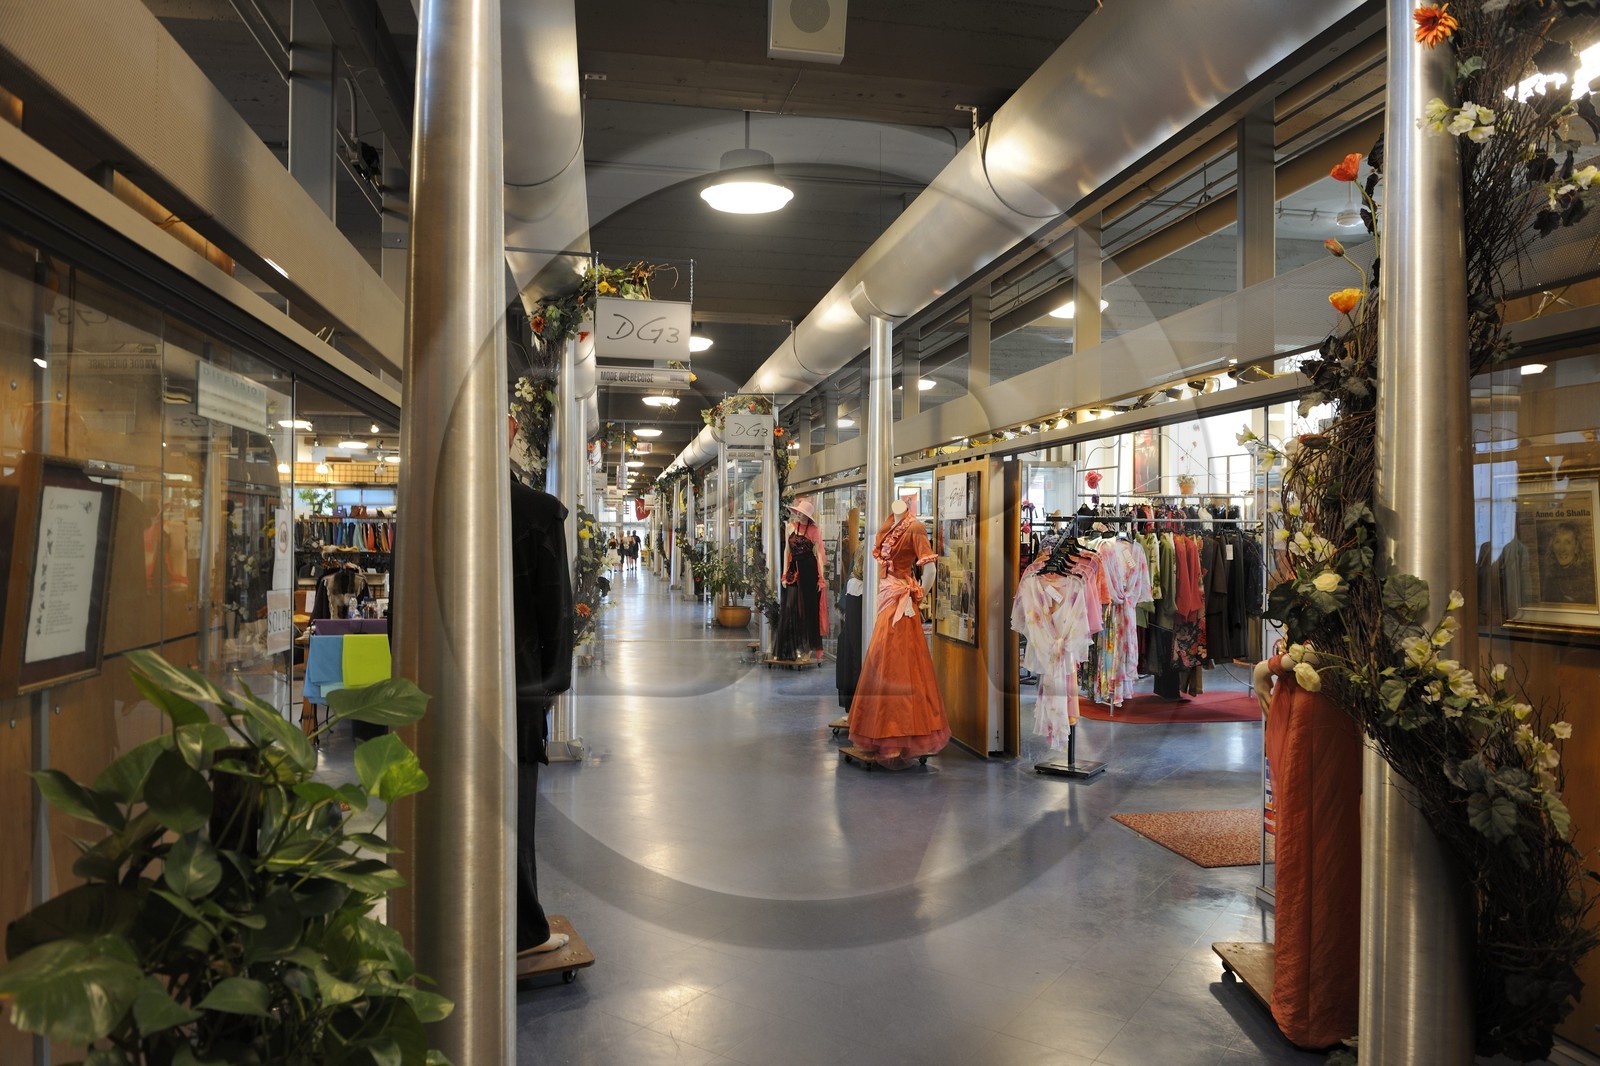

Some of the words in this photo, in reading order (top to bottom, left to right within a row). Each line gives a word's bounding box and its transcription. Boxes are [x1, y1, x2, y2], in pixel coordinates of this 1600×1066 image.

[607, 313, 680, 344] DG3
[600, 371, 618, 381] MODE
[618, 371, 654, 383] QUÉBÉCOISE
[731, 422, 769, 437] DG3
